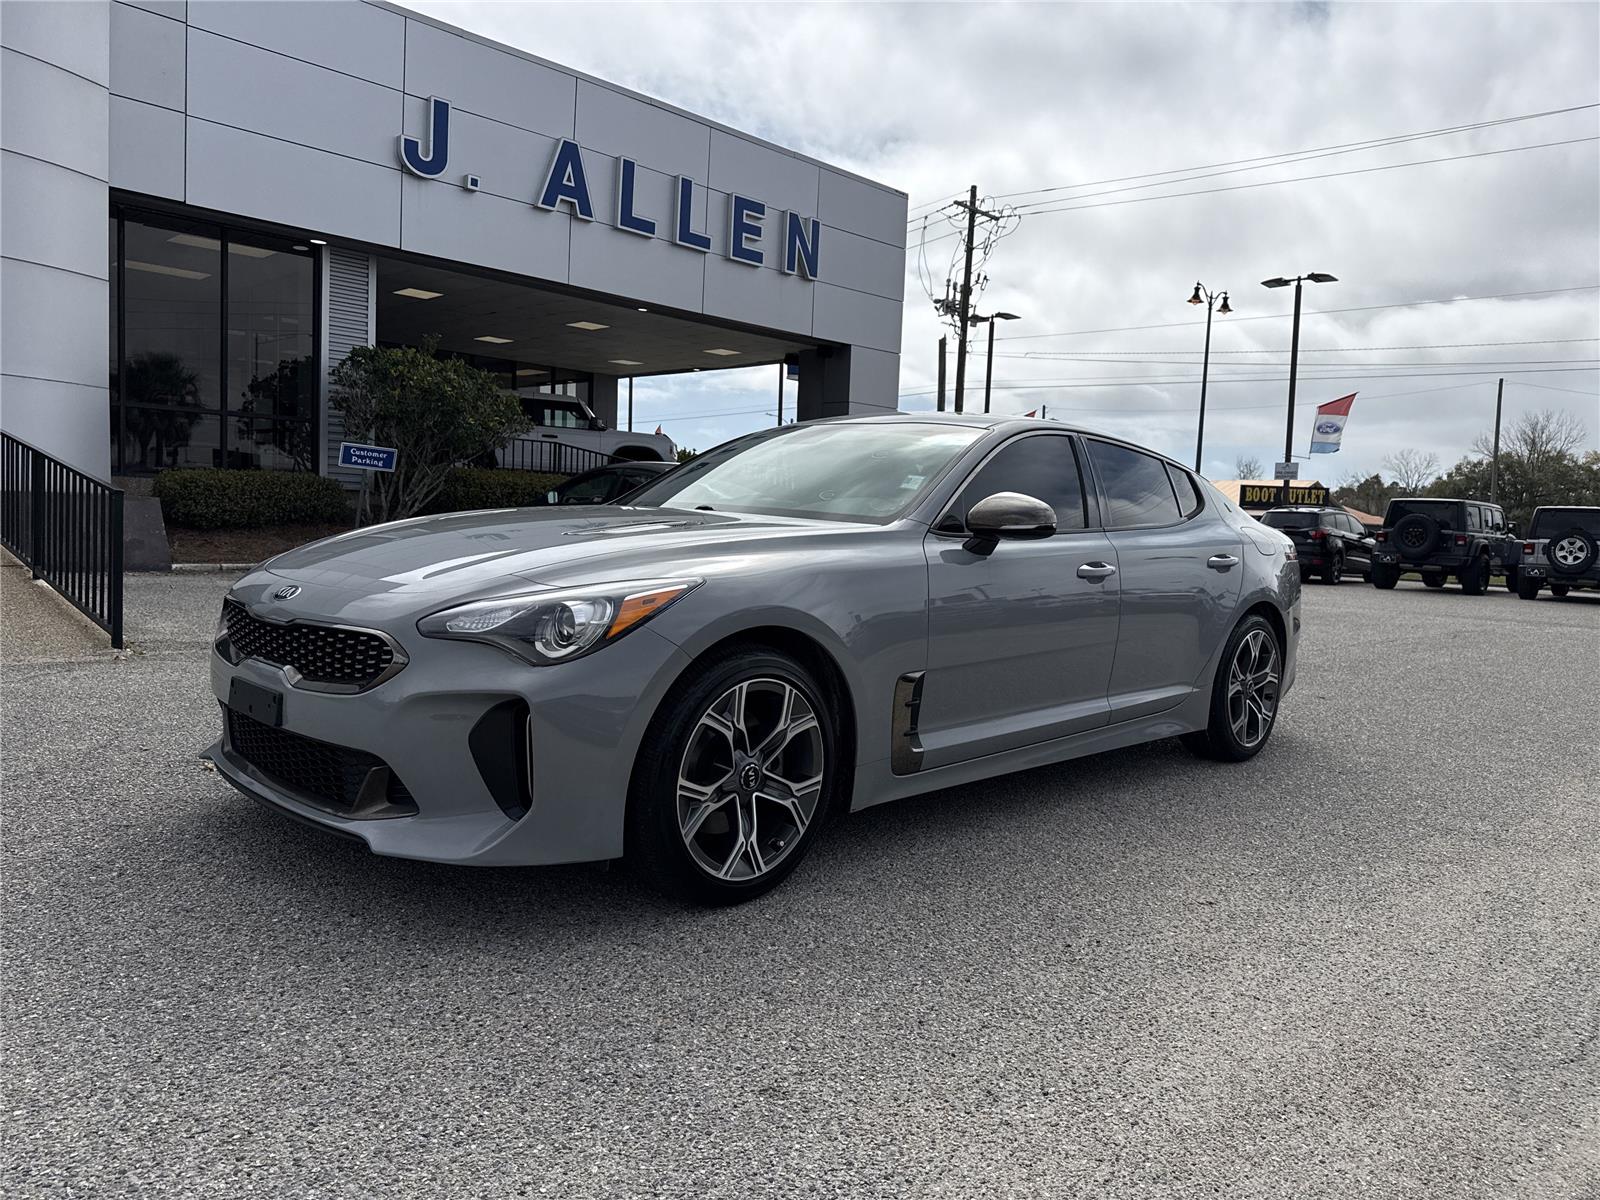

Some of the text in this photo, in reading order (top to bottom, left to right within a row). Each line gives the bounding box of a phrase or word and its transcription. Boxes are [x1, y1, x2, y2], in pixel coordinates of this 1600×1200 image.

[398, 95, 822, 280] J. ALLEN
[350, 448, 388, 459] Customer
[351, 456, 384, 467] Parking
[1245, 487, 1326, 504] BOOT UTLET
[748, 768, 756, 787] KIA
